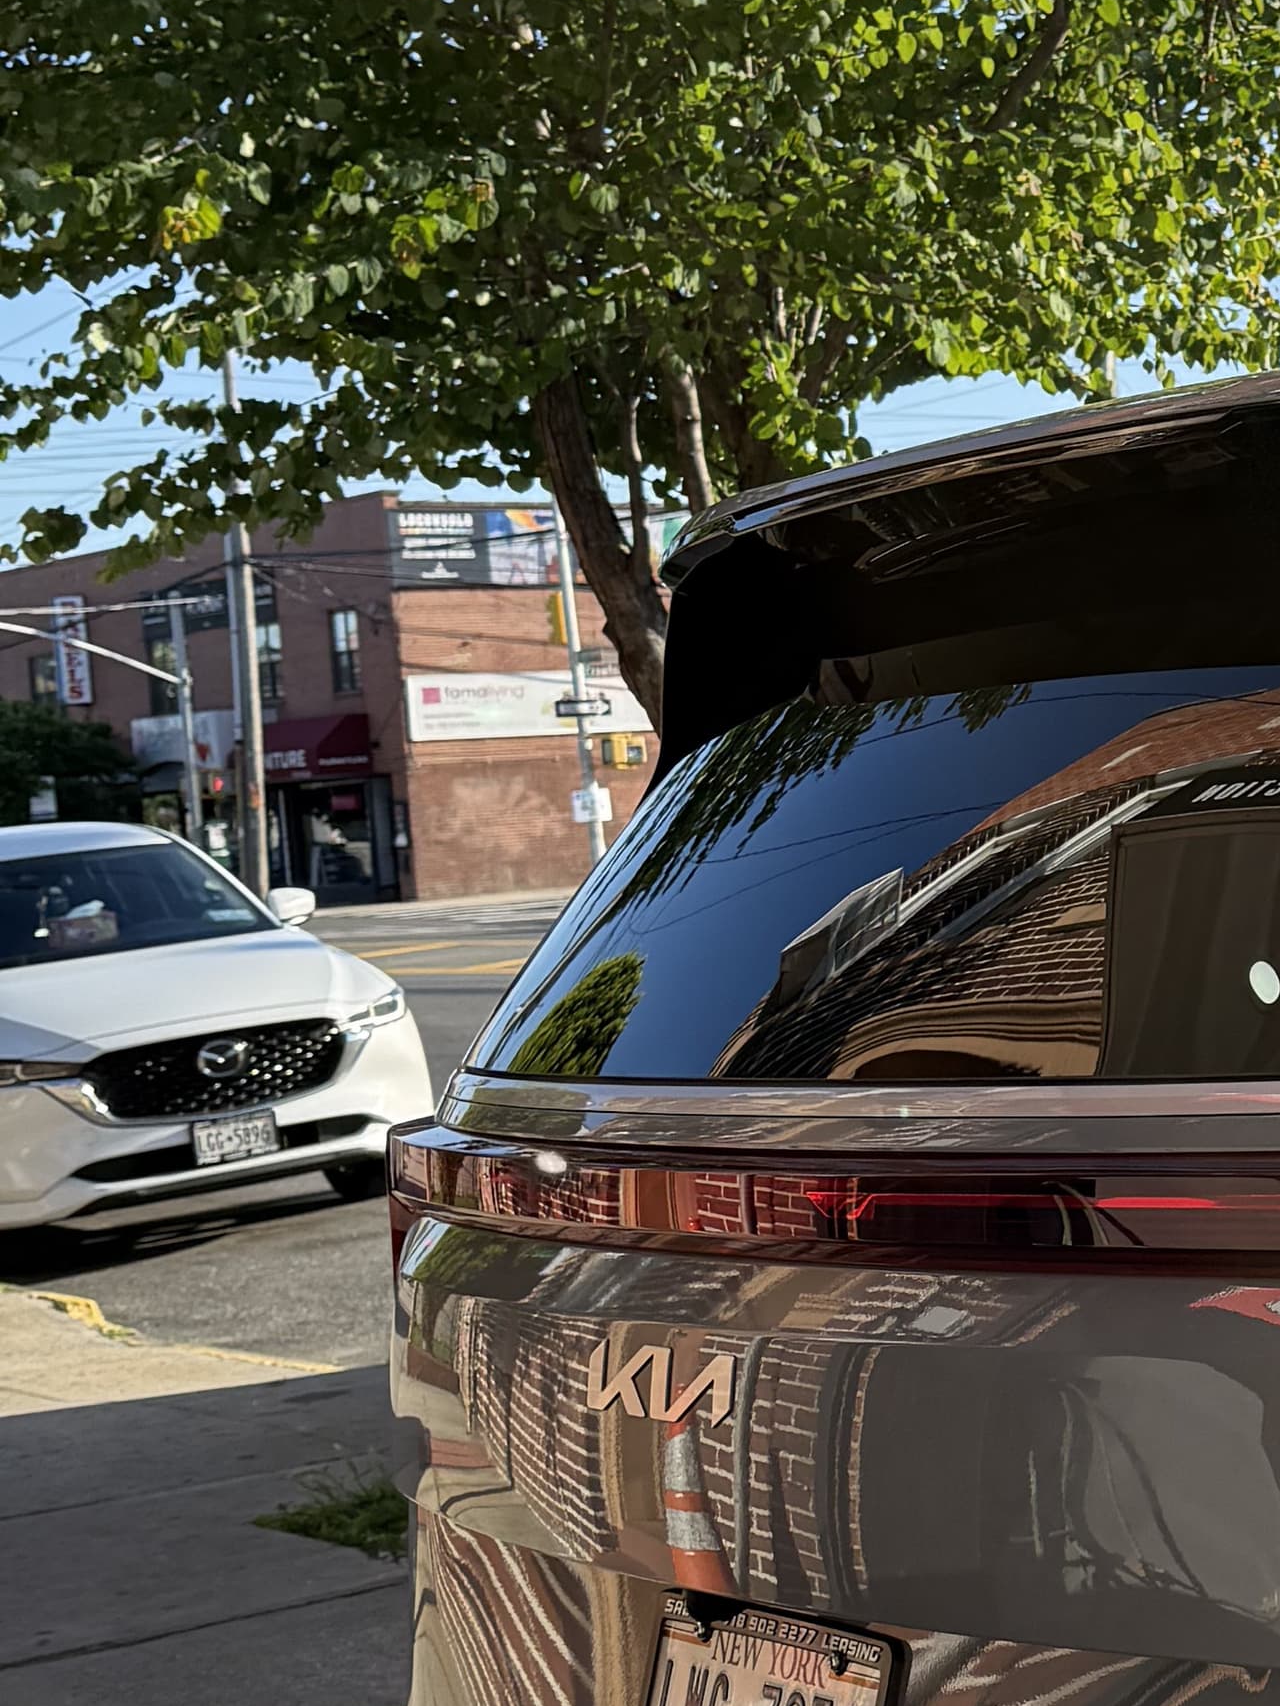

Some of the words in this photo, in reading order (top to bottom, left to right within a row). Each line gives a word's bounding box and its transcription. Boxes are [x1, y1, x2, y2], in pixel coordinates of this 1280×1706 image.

[586, 1338, 738, 1429] KIA
[711, 1629, 765, 1671] NEW
[767, 1643, 829, 1689] YORK
[749, 1616, 777, 1635] 902
[780, 1623, 818, 1645] 2277
[821, 1633, 883, 1663] LEASING
